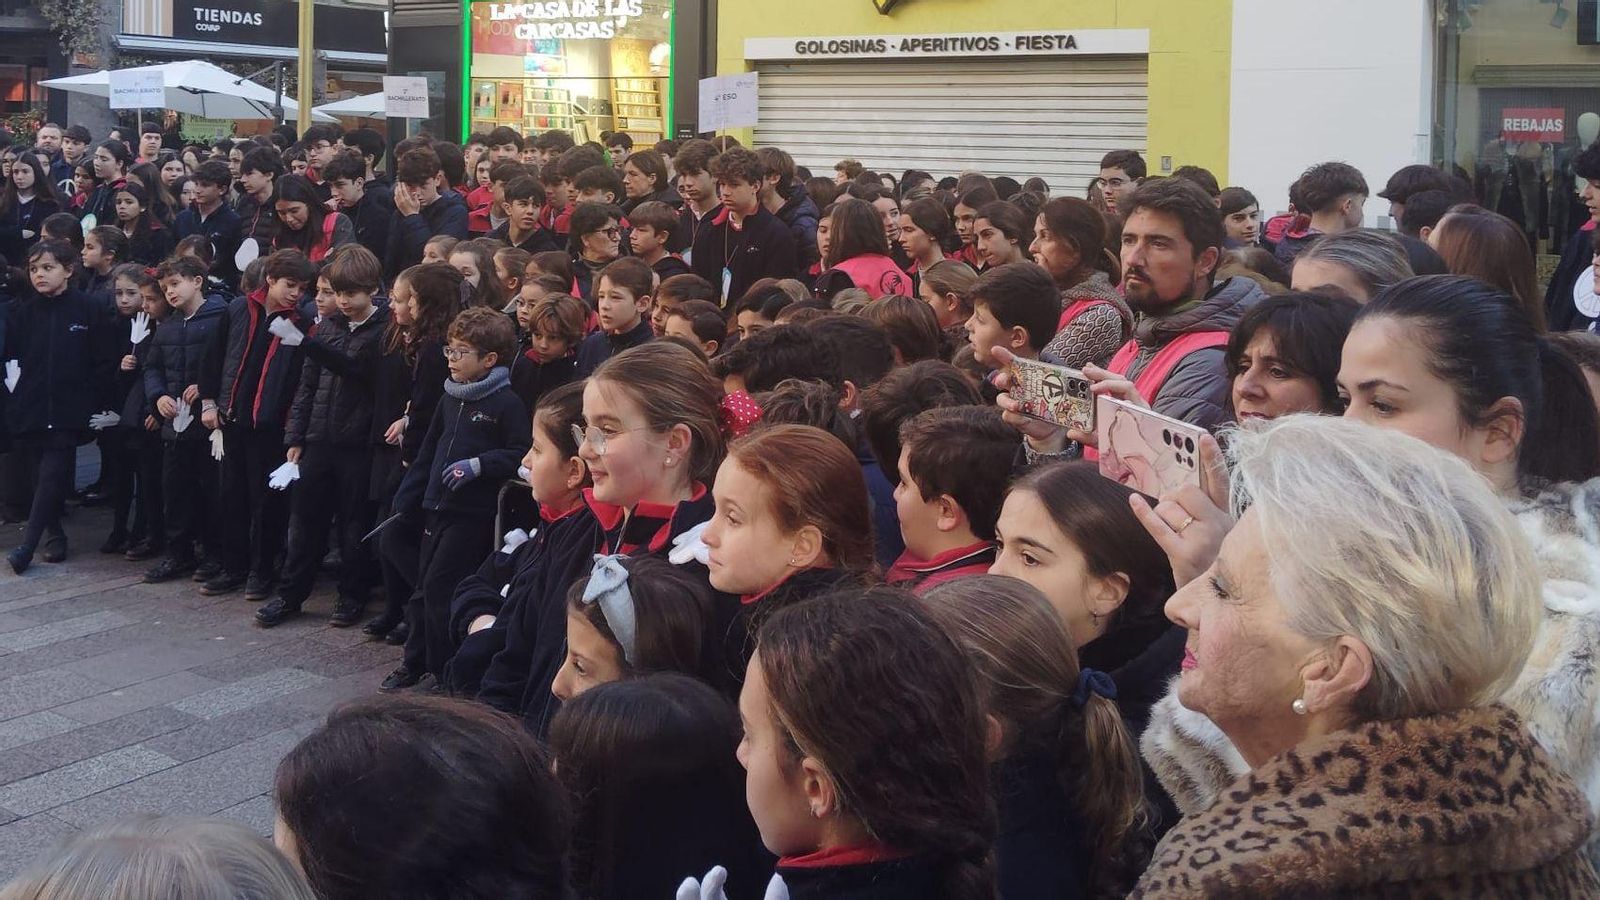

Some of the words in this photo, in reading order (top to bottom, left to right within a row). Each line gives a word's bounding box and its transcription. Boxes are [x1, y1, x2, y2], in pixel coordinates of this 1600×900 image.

[193, 7, 262, 25] TIENDAS
[489, 3, 516, 20] LA
[522, 1, 570, 19] CASA
[572, 0, 599, 17] DE
[603, 0, 642, 16] LAS
[514, 21, 614, 39] CARCASAS
[795, 39, 886, 55] GOLOSINAS
[900, 37, 999, 52] APERITIVOS
[1015, 35, 1077, 50] FIESTA
[722, 92, 737, 101] ESO
[1503, 118, 1564, 132] REBAJAS
